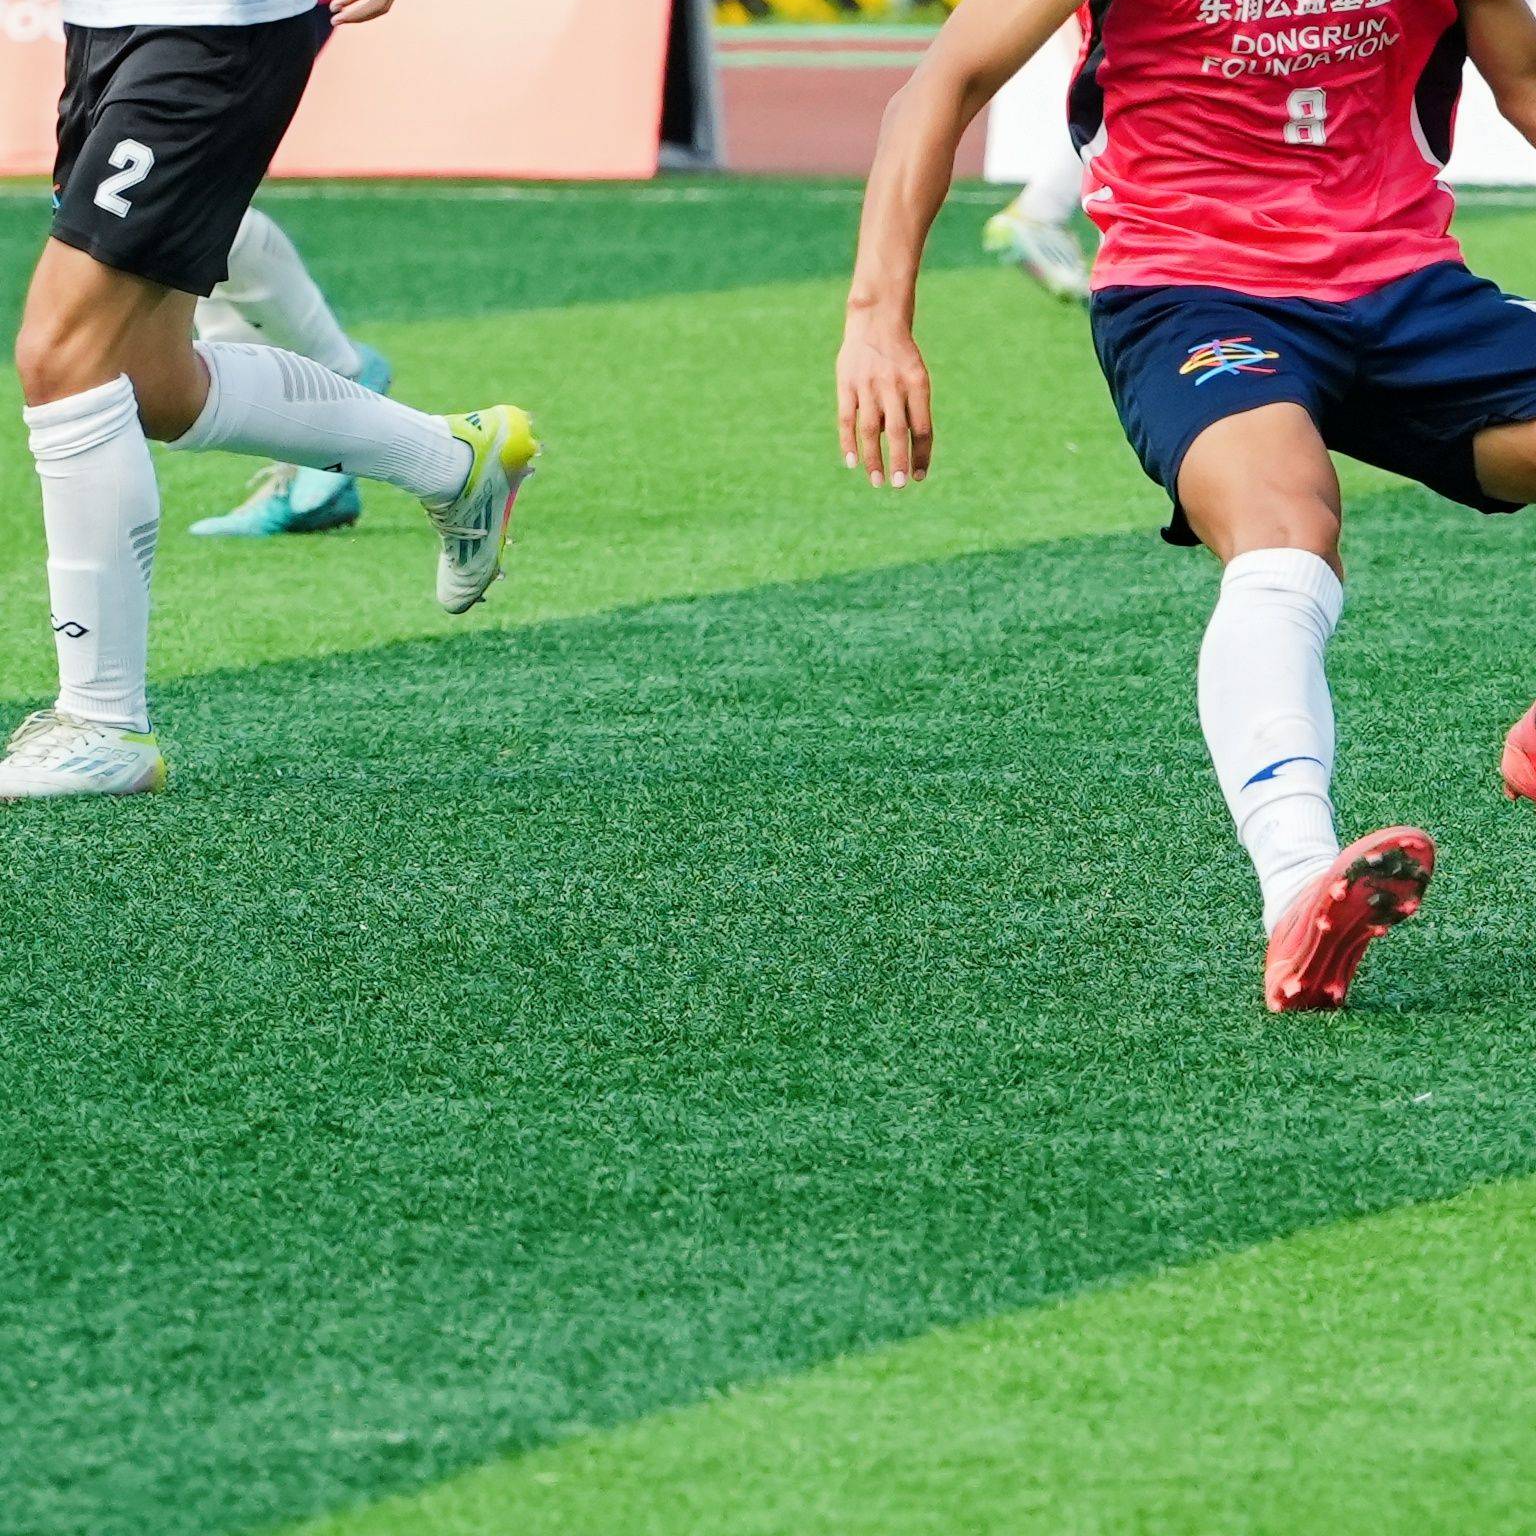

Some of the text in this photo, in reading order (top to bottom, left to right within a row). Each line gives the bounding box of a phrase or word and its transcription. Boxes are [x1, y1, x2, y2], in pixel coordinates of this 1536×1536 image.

[1201, 32, 1400, 79] FOUNDATION
[1231, 17, 1387, 57] DONGRUN
[1283, 87, 1327, 145] 8
[93, 138, 155, 219] 2
